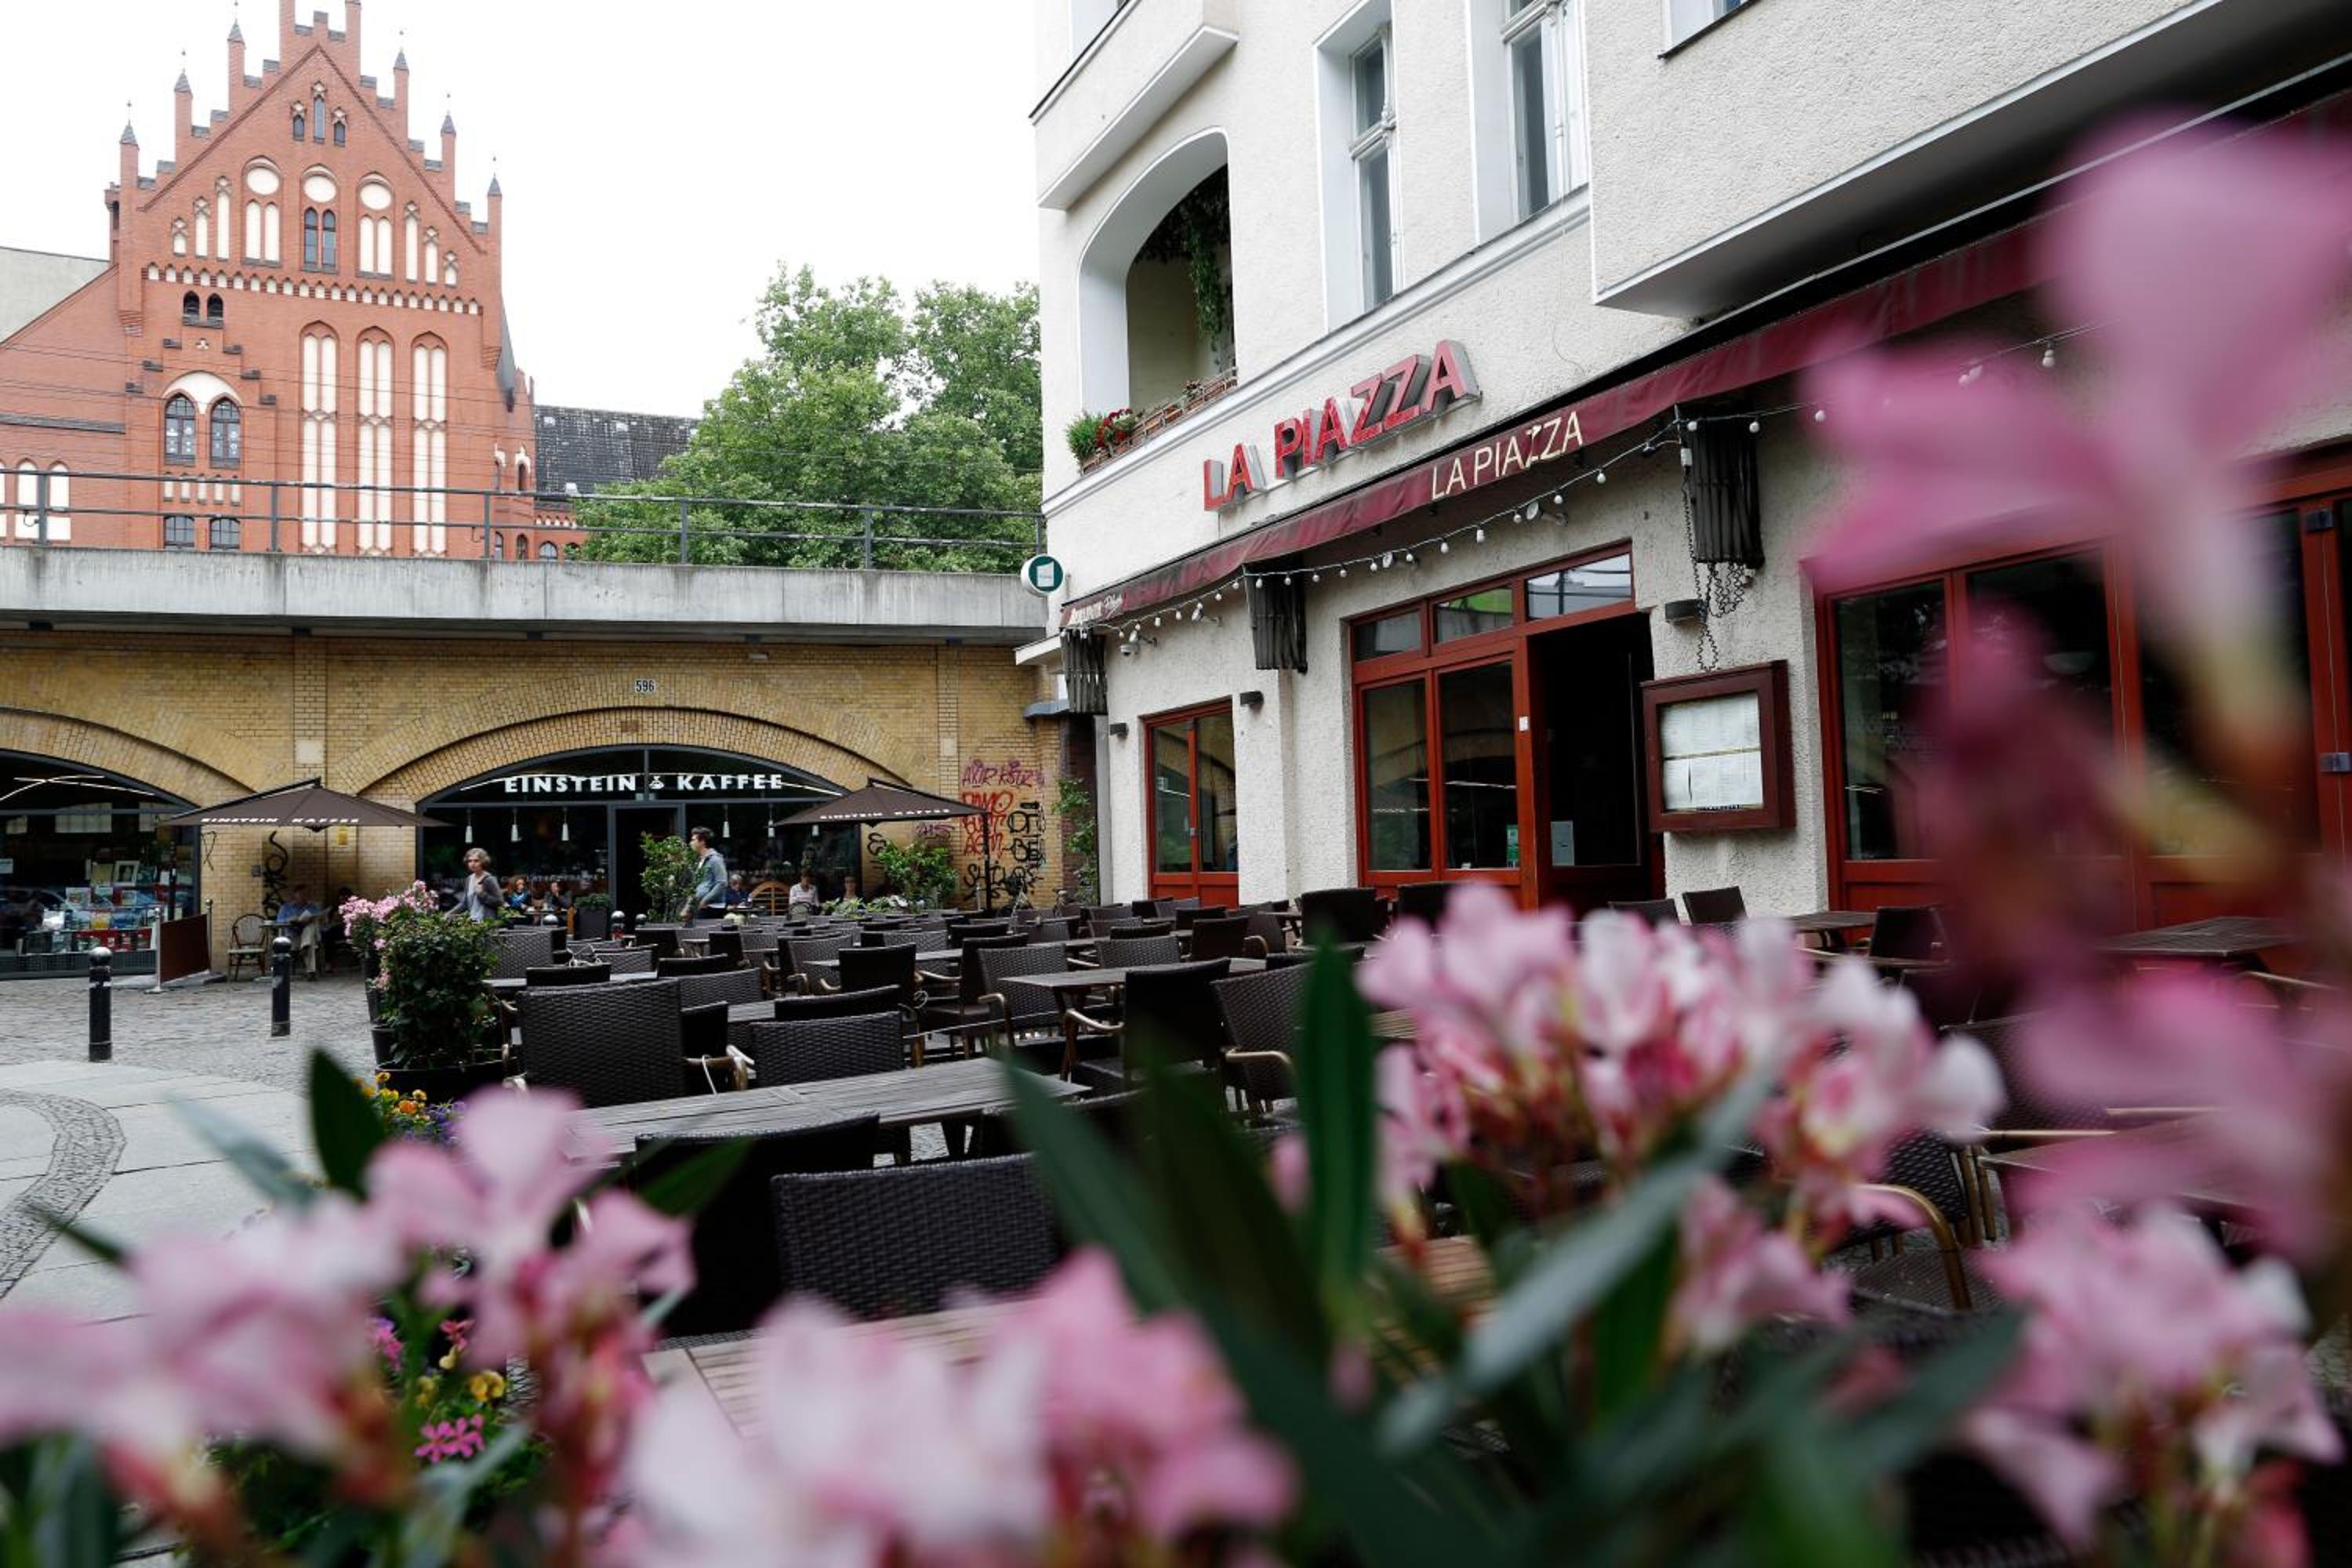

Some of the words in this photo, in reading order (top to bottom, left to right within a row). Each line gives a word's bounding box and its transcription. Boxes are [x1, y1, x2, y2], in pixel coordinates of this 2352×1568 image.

[1204, 443, 1259, 510] LA
[1275, 339, 1472, 477] PIAZZA
[1432, 457, 1466, 500] LA
[1473, 411, 1583, 485] PIAZZA
[636, 680, 655, 691] 596
[504, 775, 636, 793] EINSTEIN
[677, 774, 782, 790] KAFFEE
